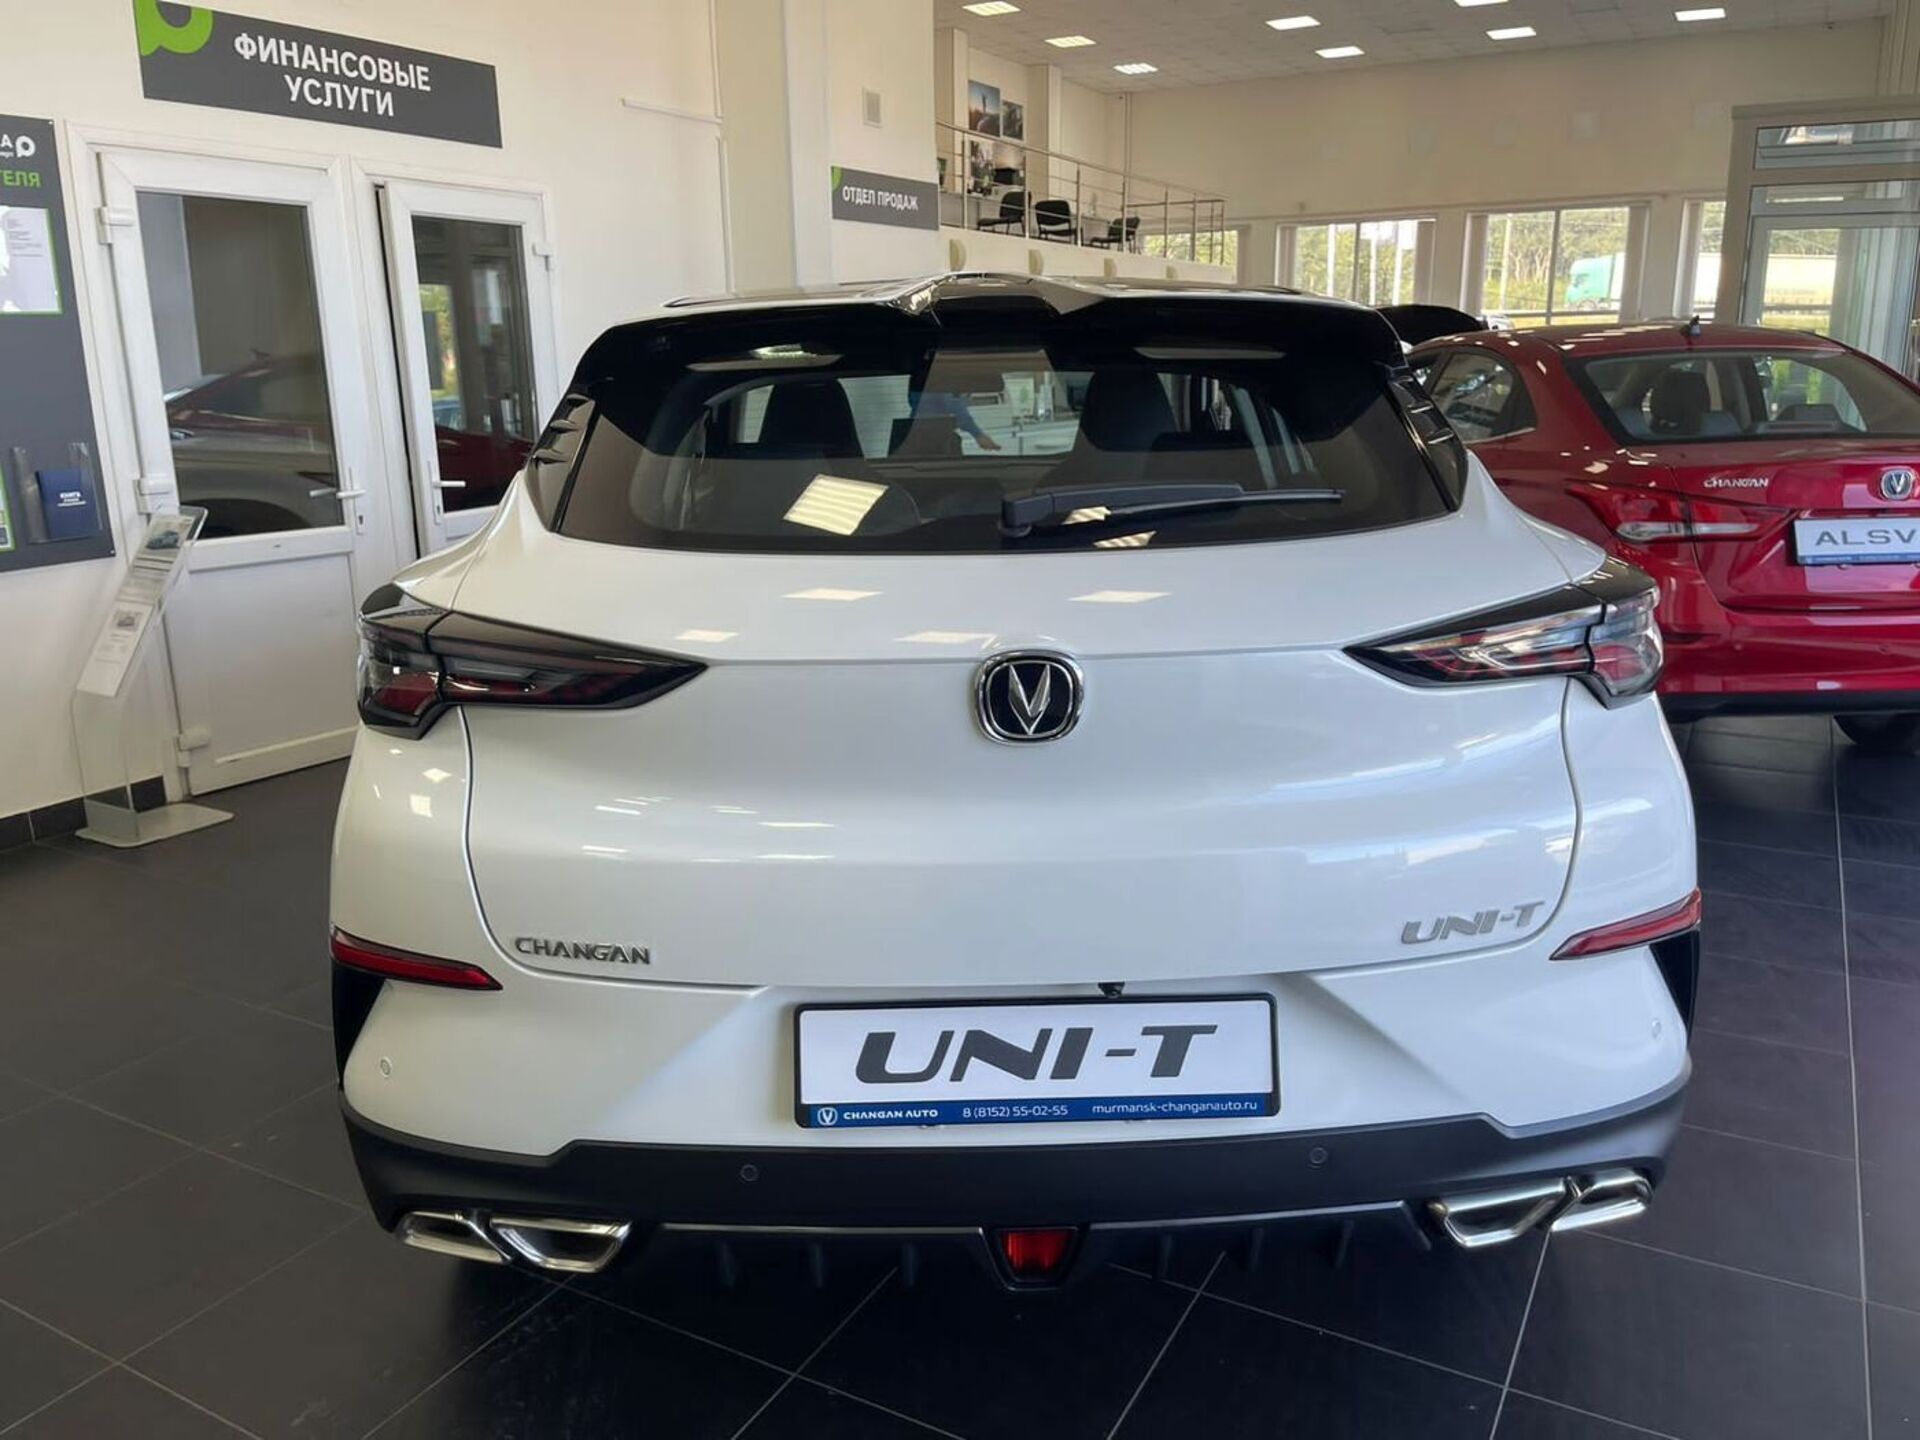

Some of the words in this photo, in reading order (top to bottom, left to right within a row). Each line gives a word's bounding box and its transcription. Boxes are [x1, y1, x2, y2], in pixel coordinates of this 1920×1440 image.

[234, 33, 431, 91] ФИНАНСОВЫЕ
[284, 74, 394, 117] УСЛУГИ
[0, 170, 41, 189] ЕЛЯ
[842, 186, 876, 206] ОТДЕЛ
[877, 191, 919, 211] ПРОДАЖ
[1401, 901, 1545, 945] UNI-T
[514, 937, 651, 965] CHANGAN
[855, 1024, 1218, 1084] UNI-T
[843, 1110, 903, 1120] CHANGAN
[906, 1108, 939, 1119] AUTO
[962, 1107, 971, 1118] 8
[973, 1105, 1010, 1119] (8152)
[1012, 1104, 1069, 1117] 55-02-55
[1092, 1100, 1258, 1115] murmansk-changanauto.ru
